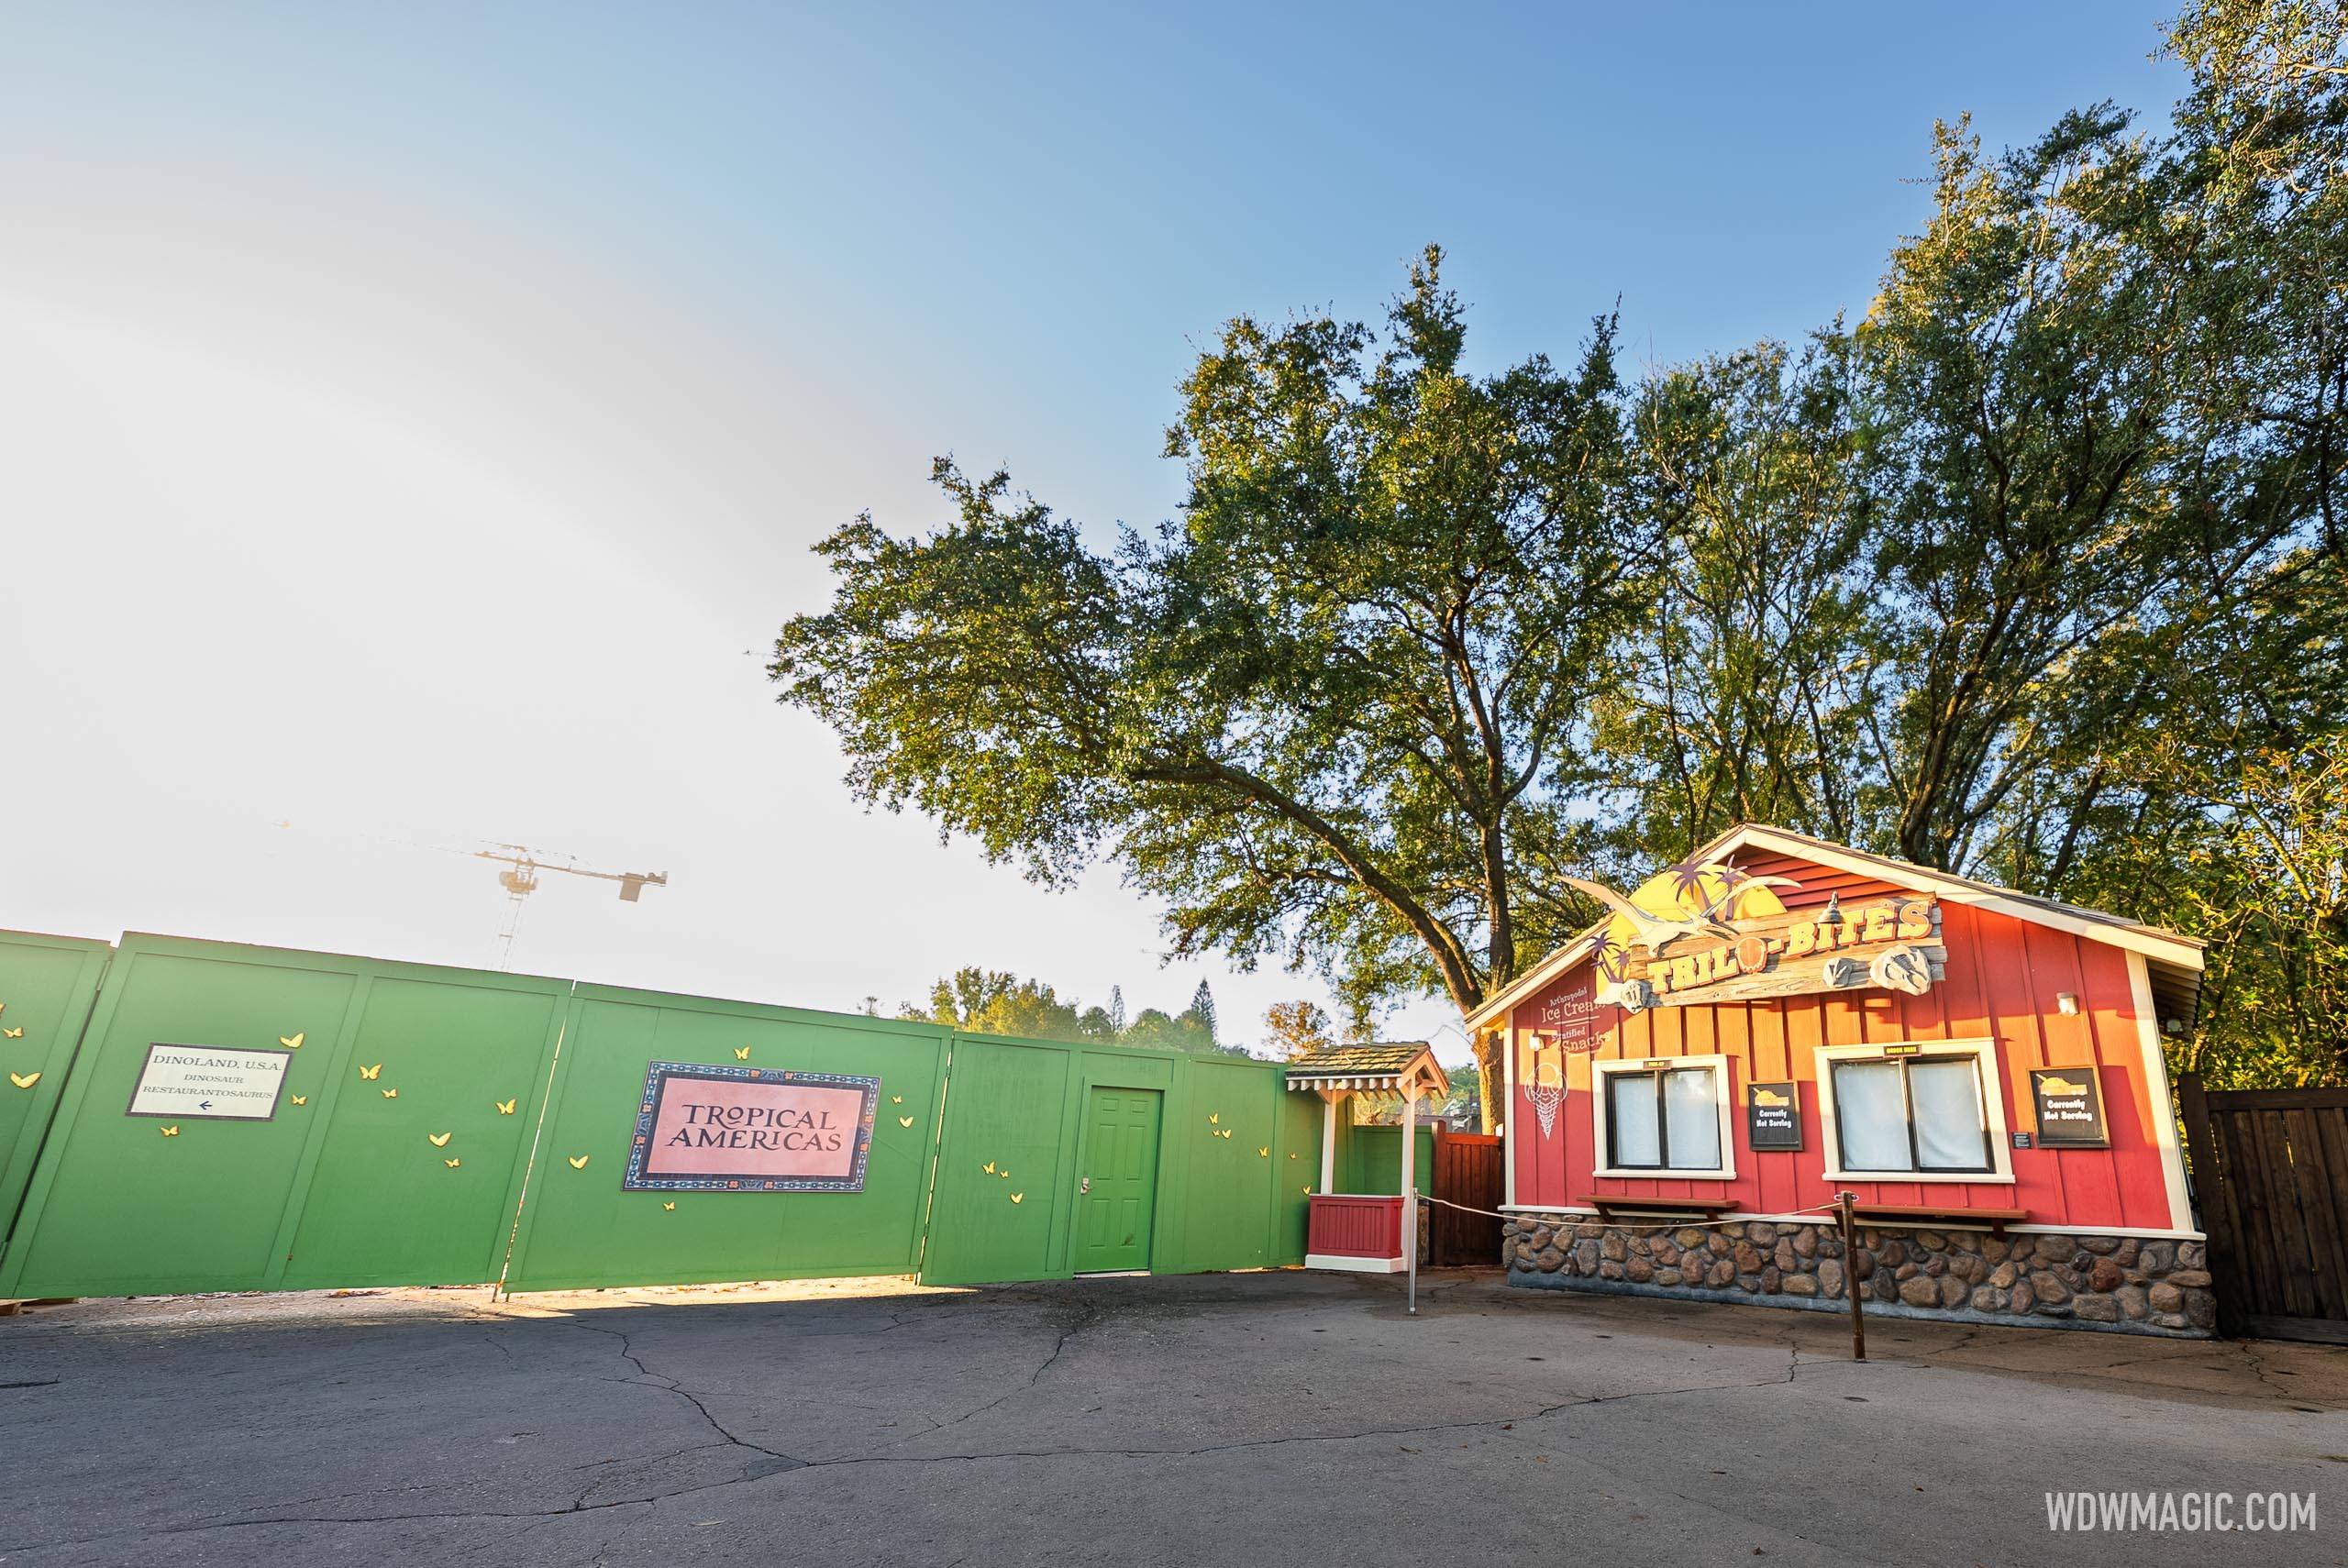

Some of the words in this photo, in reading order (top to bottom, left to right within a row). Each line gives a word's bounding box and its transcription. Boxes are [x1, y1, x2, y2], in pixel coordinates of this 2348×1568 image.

[1549, 987, 1587, 1006] Arthropodal
[1541, 1007, 1561, 1023] Ice
[1562, 1031, 1611, 1054] Snacks
[245, 1061, 282, 1072] U.S.A.
[183, 1074, 244, 1084] DINOSAUR
[143, 1086, 273, 1099] RESTAURANTOSAURUS
[2047, 1099, 2086, 1110] Currently
[681, 1104, 836, 1129] TROPICAL
[1759, 1110, 1787, 1118] Currently
[2043, 1110, 2059, 1121] Not
[2061, 1110, 2092, 1121] Serving
[1755, 1119, 1767, 1128] Not
[1769, 1119, 1791, 1128] Serving
[667, 1128, 841, 1152] AMERICAS
